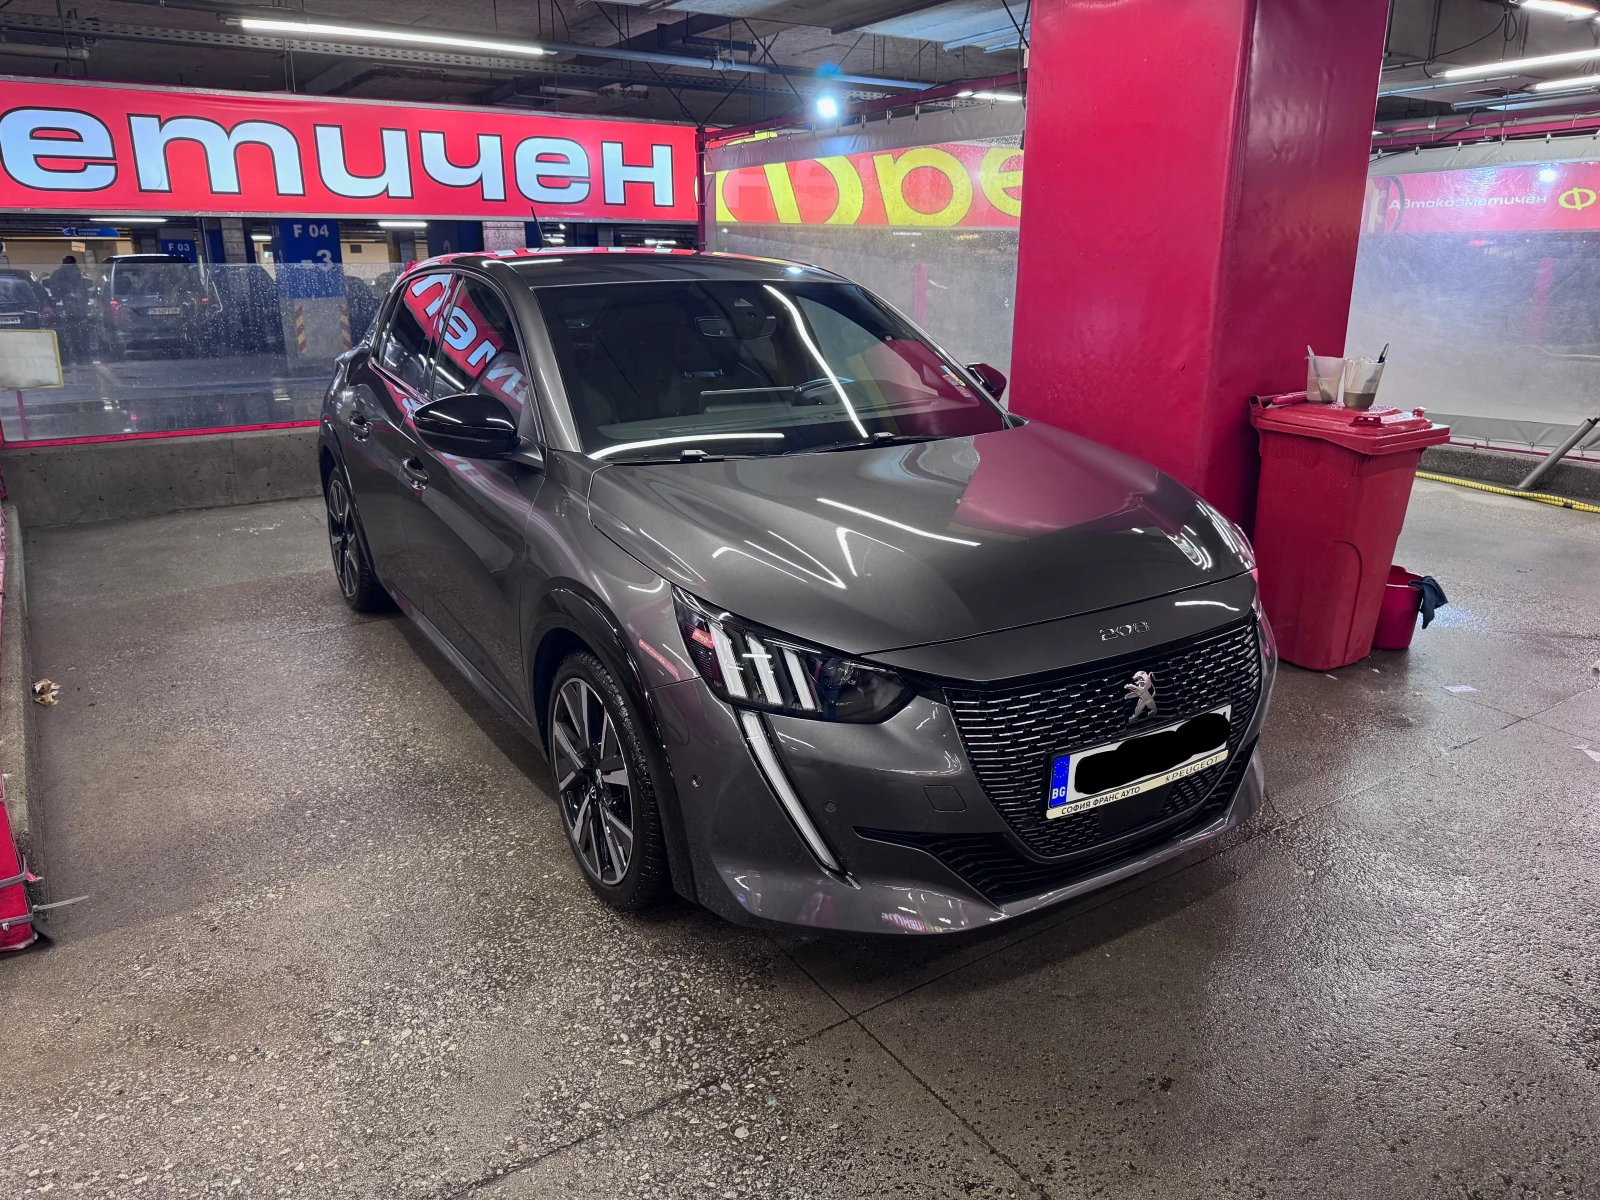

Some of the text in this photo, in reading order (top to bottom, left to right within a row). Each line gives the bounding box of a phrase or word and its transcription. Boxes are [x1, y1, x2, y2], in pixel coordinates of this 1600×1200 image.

[0, 106, 674, 206] етичен
[293, 224, 329, 238] F 04
[168, 243, 190, 252] F 03
[1099, 621, 1150, 641] 208
[1171, 754, 1220, 781] PEUGEOT
[1051, 786, 1066, 800] BG
[1061, 785, 1141, 815] СОФИЯ ФРАНС АУТО
